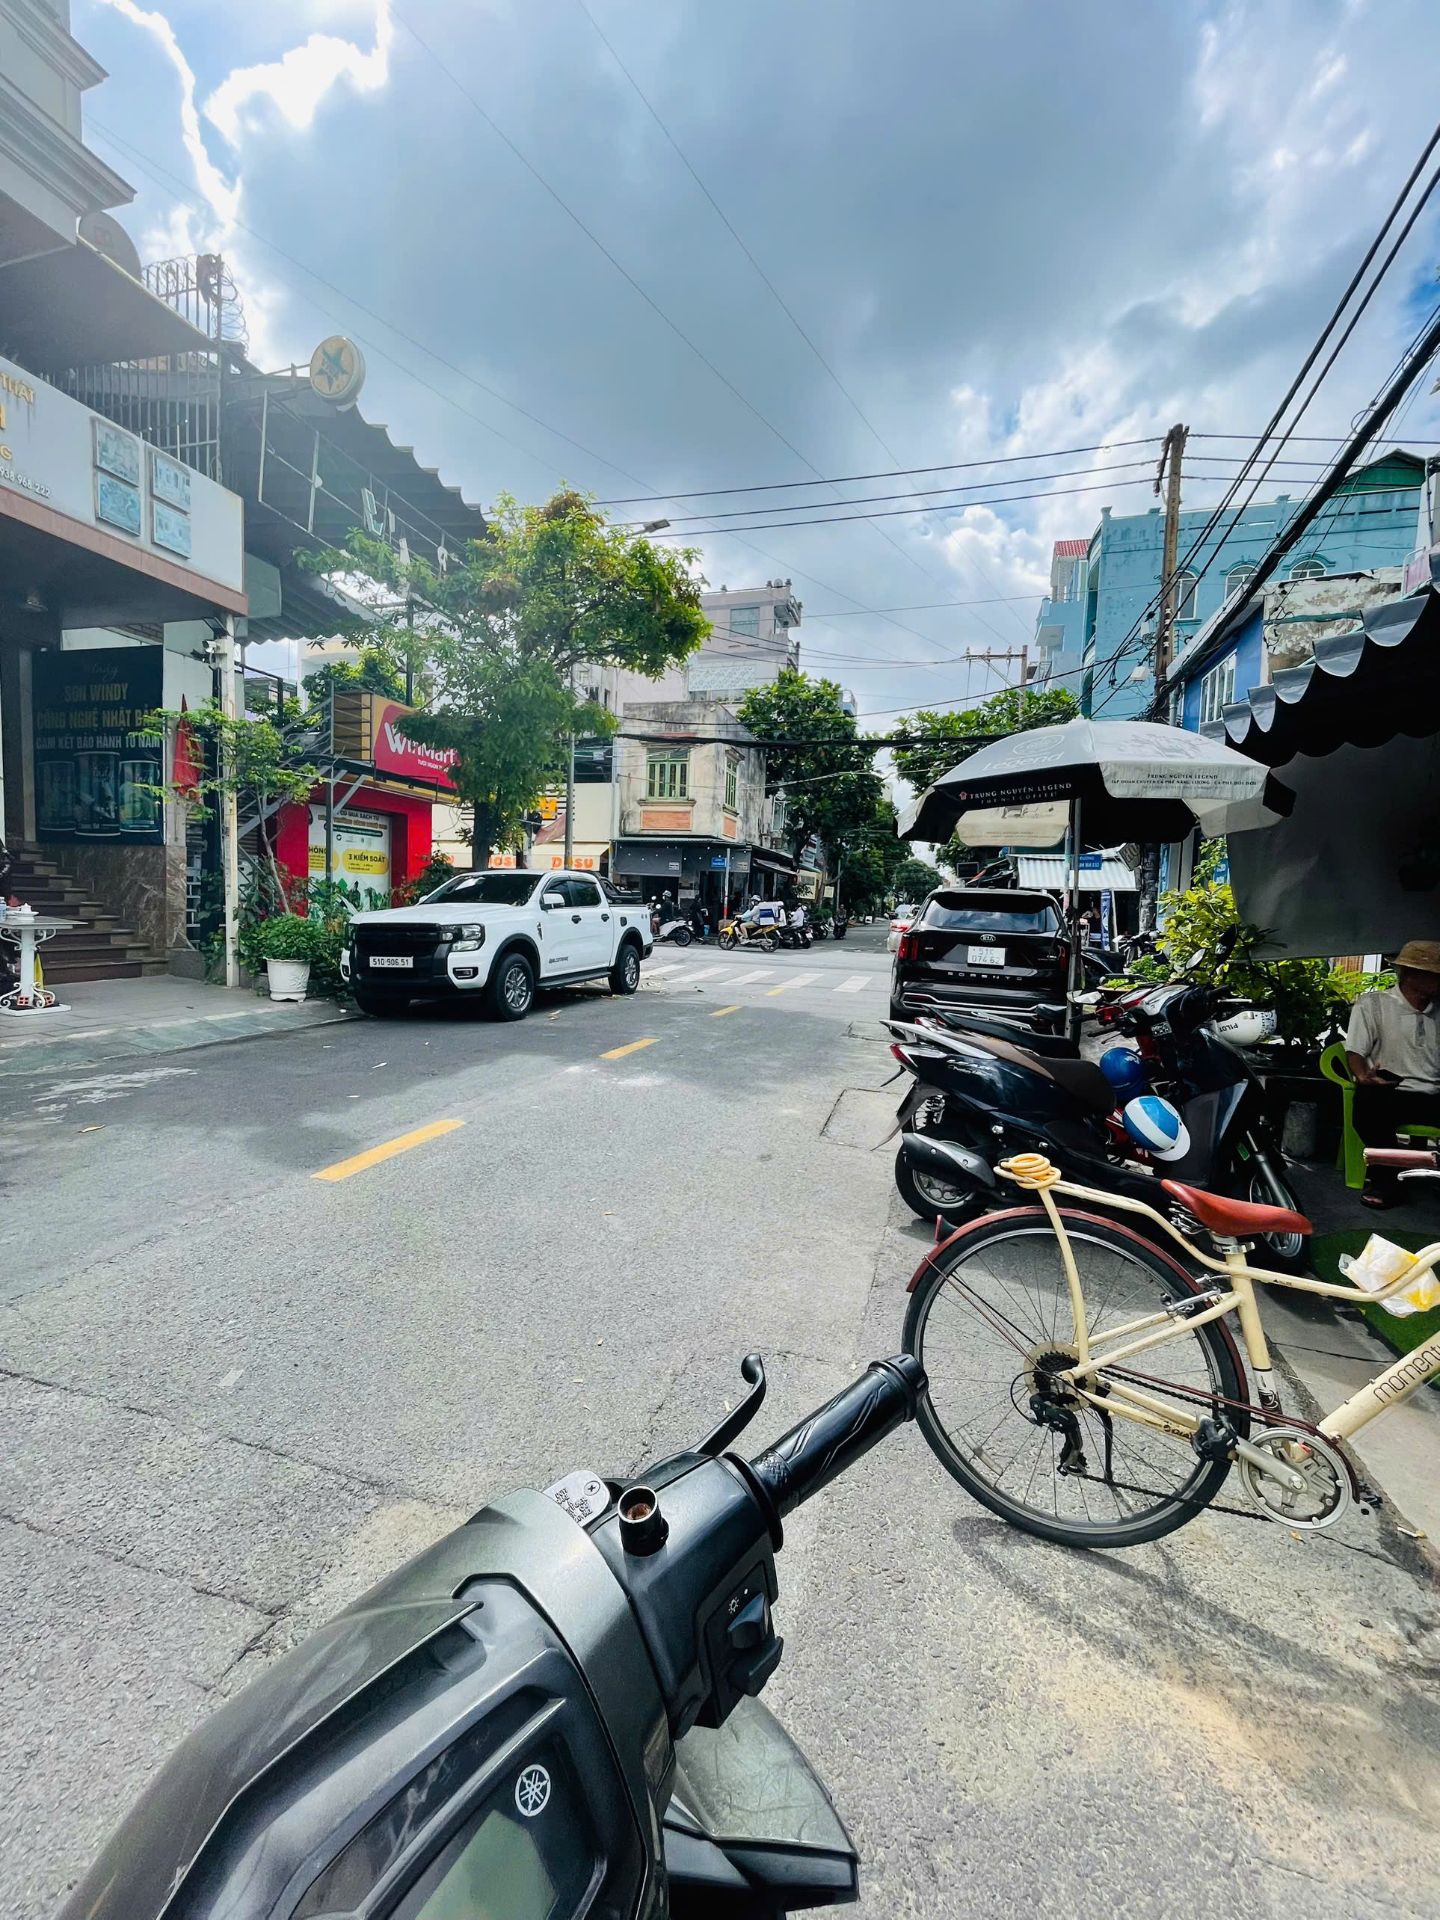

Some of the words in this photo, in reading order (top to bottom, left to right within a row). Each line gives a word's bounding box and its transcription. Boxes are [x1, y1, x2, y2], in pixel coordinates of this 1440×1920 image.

[90, 682, 128, 700] WINDY
[970, 791, 997, 800] TRUNG
[1000, 785, 1034, 797] NGUYÊN
[1037, 782, 1072, 792] LEGEND
[1219, 1023, 1238, 1033] PILOT
[1373, 1344, 1440, 1404] moment
